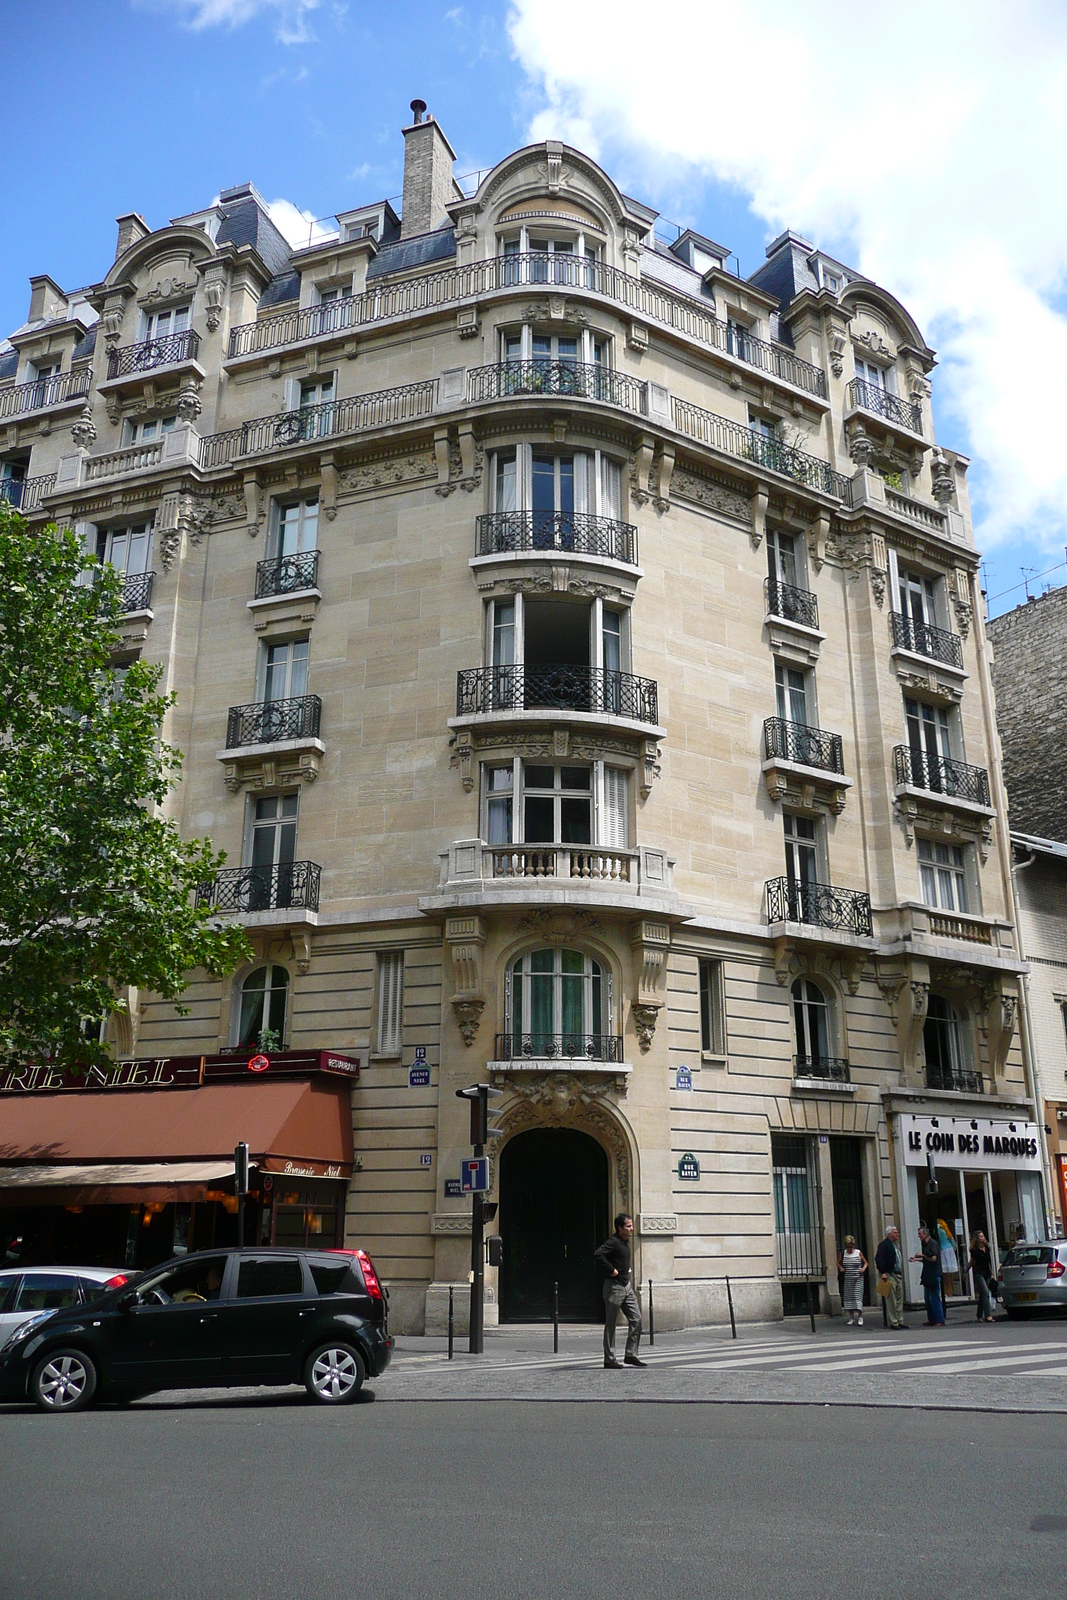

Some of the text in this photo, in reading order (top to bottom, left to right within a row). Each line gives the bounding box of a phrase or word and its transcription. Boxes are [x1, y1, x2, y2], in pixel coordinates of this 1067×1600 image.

[417, 1048, 425, 1058] 12
[328, 1058, 357, 1072] RESTAURANT
[0, 1059, 174, 1090] RIE NIEL
[908, 1131, 1037, 1156] LE COIN DES MARQUES
[422, 1155, 431, 1165] 12
[284, 1161, 342, 1177] Brasserie Niel
